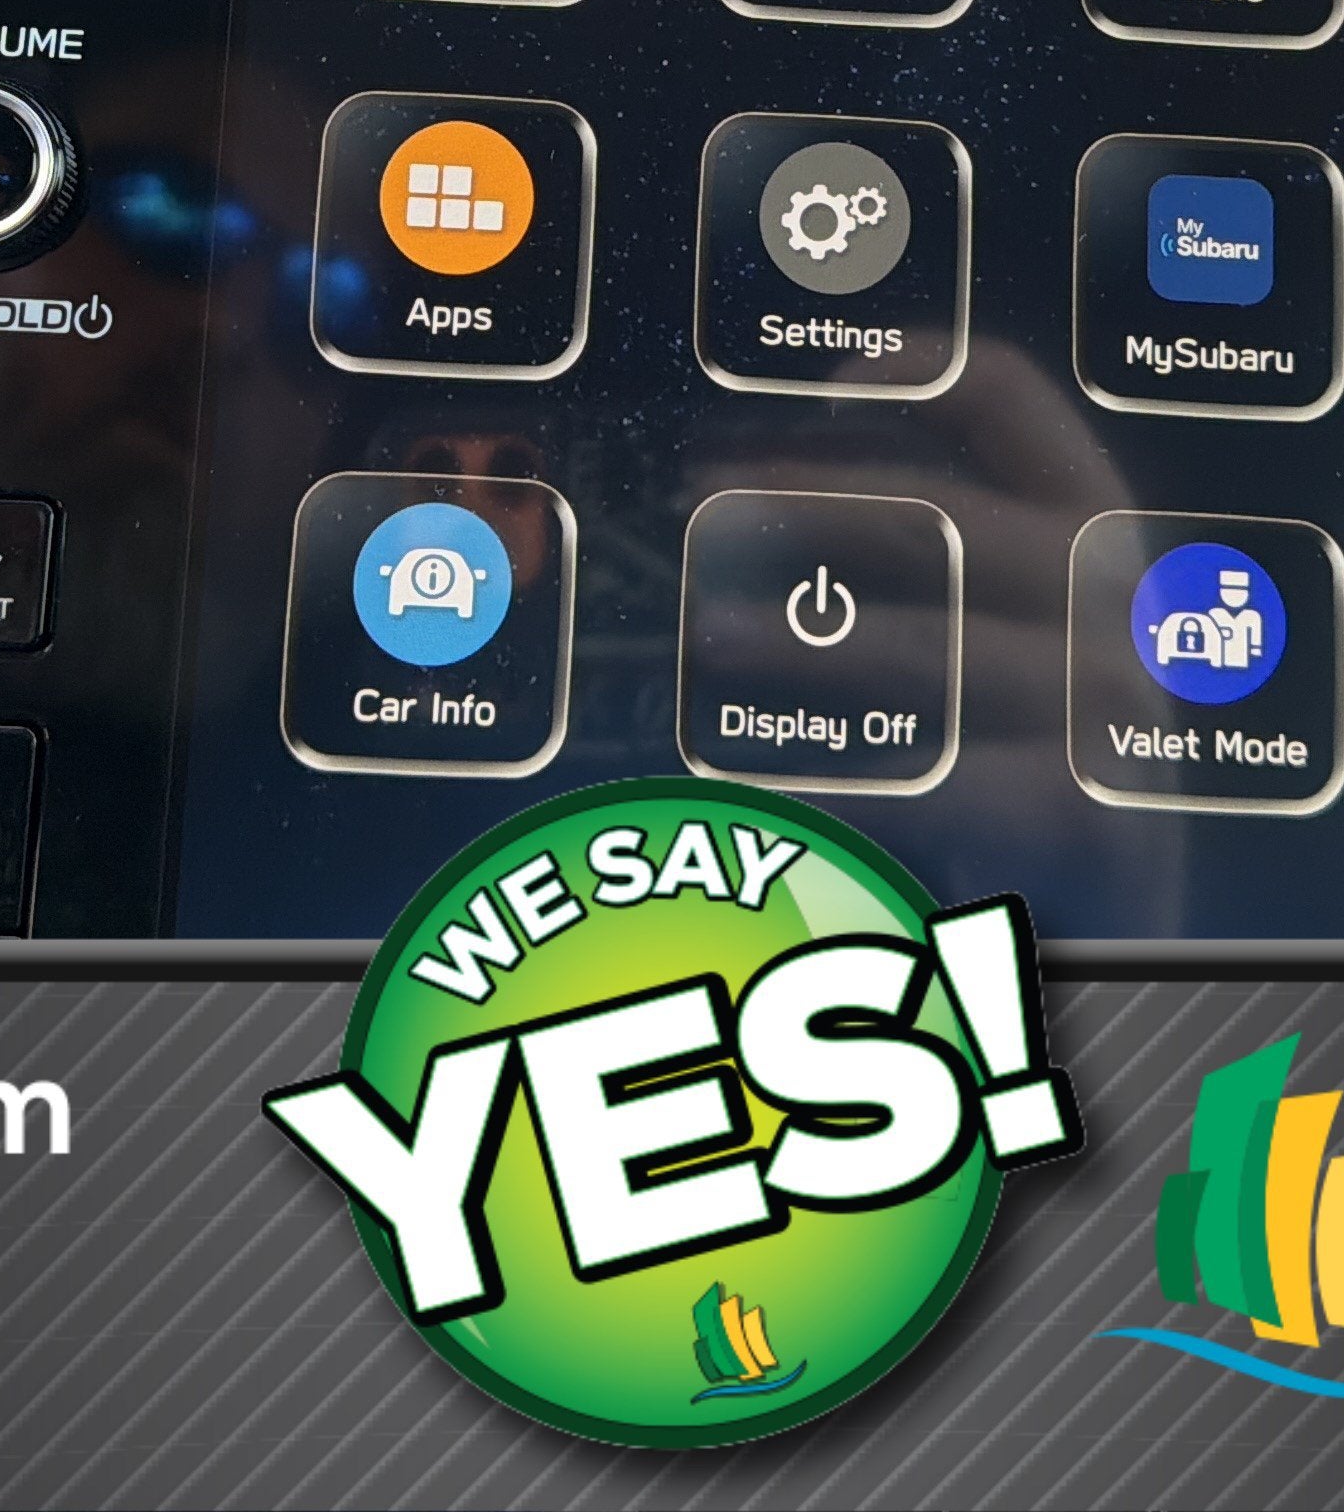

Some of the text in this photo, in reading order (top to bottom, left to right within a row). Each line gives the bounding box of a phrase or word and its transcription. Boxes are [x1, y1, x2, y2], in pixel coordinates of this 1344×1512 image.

[1176, 235, 1260, 260] Subaru
[1177, 217, 1205, 238] My
[404, 297, 494, 337] Apps
[758, 313, 904, 360] Settings
[1125, 334, 1295, 375] MySubaru
[352, 687, 497, 728] Car Info
[719, 703, 918, 751] Display Off
[1107, 722, 1309, 768] Valet Mode
